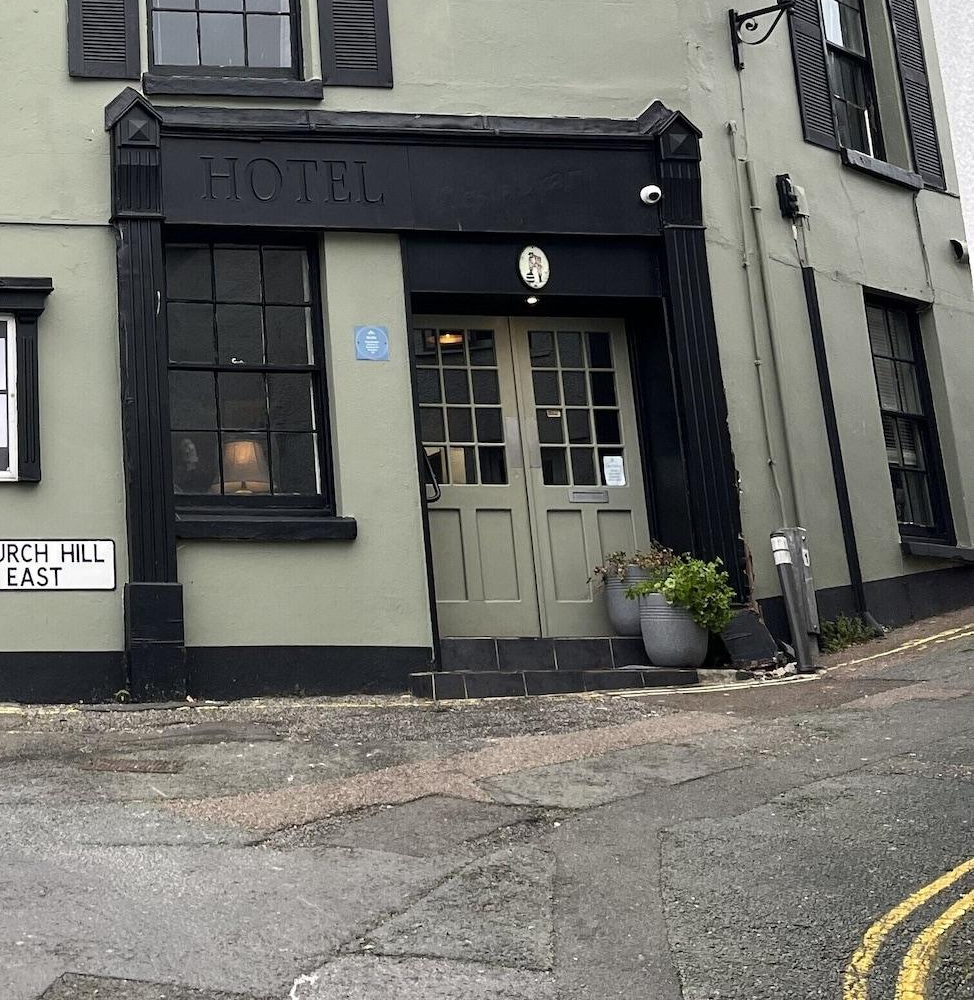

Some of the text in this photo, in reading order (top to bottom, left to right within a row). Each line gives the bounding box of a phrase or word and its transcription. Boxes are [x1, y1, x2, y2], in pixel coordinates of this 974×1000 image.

[199, 156, 385, 204] HOTEL
[61, 543, 105, 564] HILL
[7, 567, 62, 587] EAST
